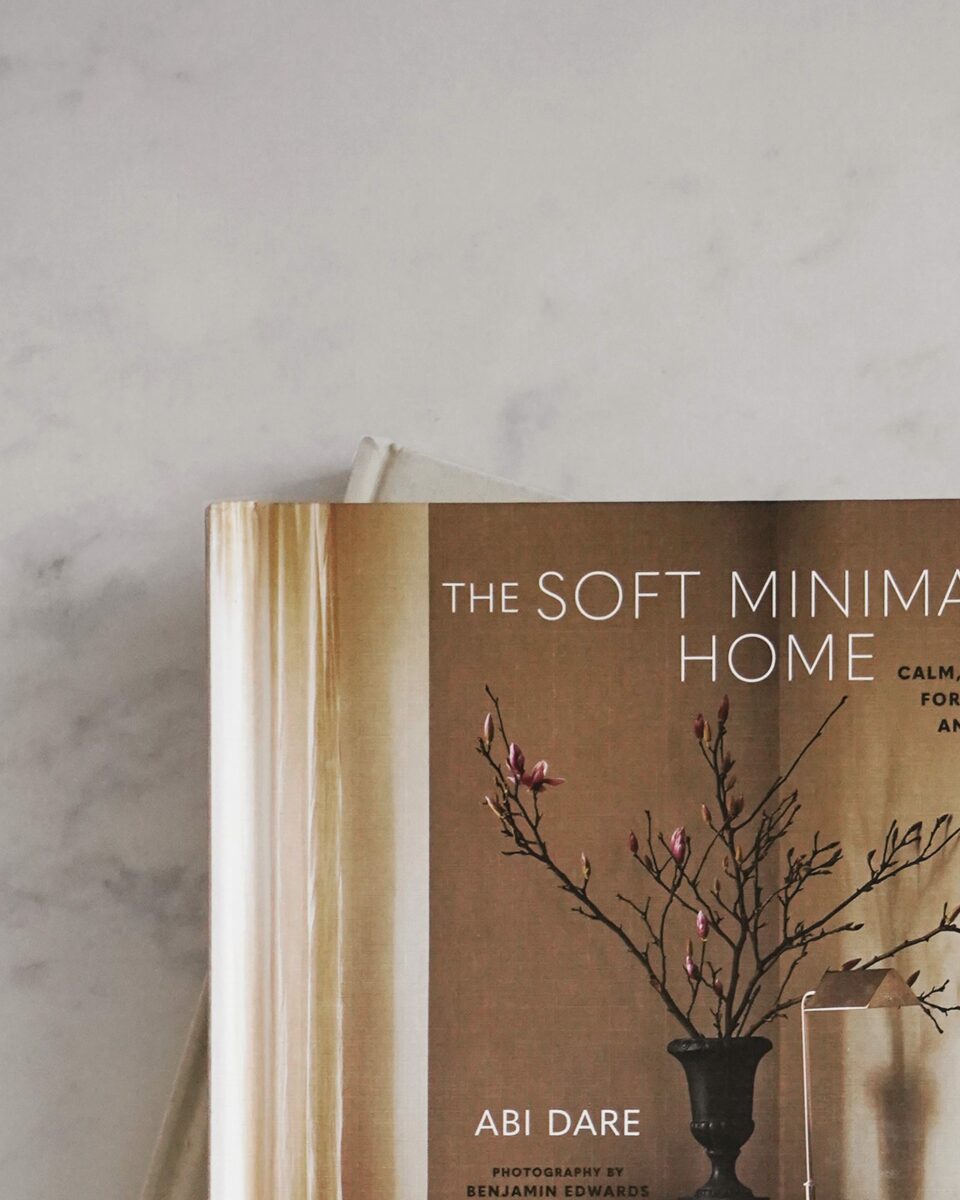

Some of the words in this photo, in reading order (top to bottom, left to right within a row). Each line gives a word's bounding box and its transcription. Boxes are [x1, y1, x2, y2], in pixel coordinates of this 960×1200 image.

[442, 583, 519, 613] THE
[537, 570, 700, 620] SOFT
[680, 633, 874, 682] HOME
[897, 665, 960, 682] CALM,
[920, 691, 960, 706] FOR
[474, 1109, 531, 1136] ABI
[548, 1109, 641, 1136] DARE
[492, 1166, 601, 1178] PHOTOGRAPHY
[606, 1166, 624, 1178] BY
[466, 1184, 557, 1198] BENJAMIN
[564, 1184, 650, 1198] EDWARDS
